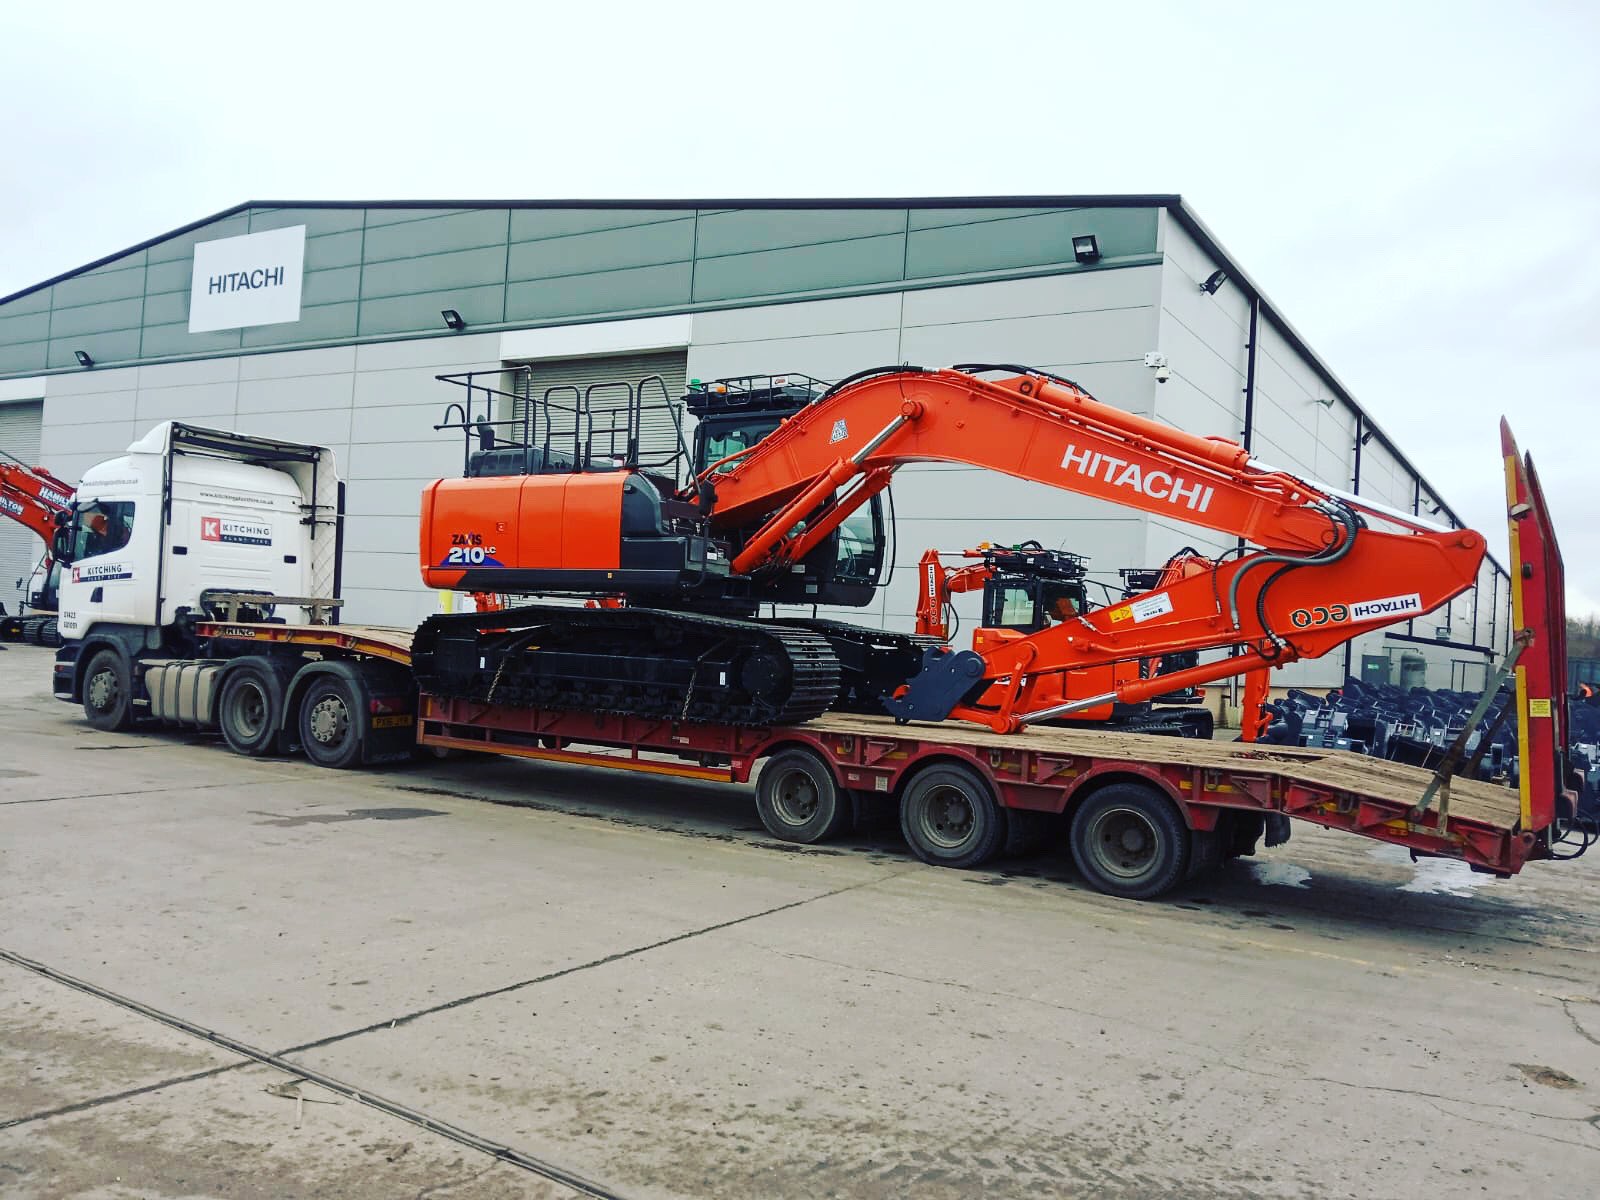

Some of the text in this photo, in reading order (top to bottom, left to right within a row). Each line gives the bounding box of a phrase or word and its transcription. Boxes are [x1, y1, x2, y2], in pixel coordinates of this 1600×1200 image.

[208, 266, 284, 295] HITACHI
[1060, 444, 1214, 513] HITACHI
[222, 524, 270, 536] KITCHING
[451, 533, 483, 546] ZAXIS
[87, 564, 122, 576] KITCHING
[1354, 597, 1418, 617] HITACHI
